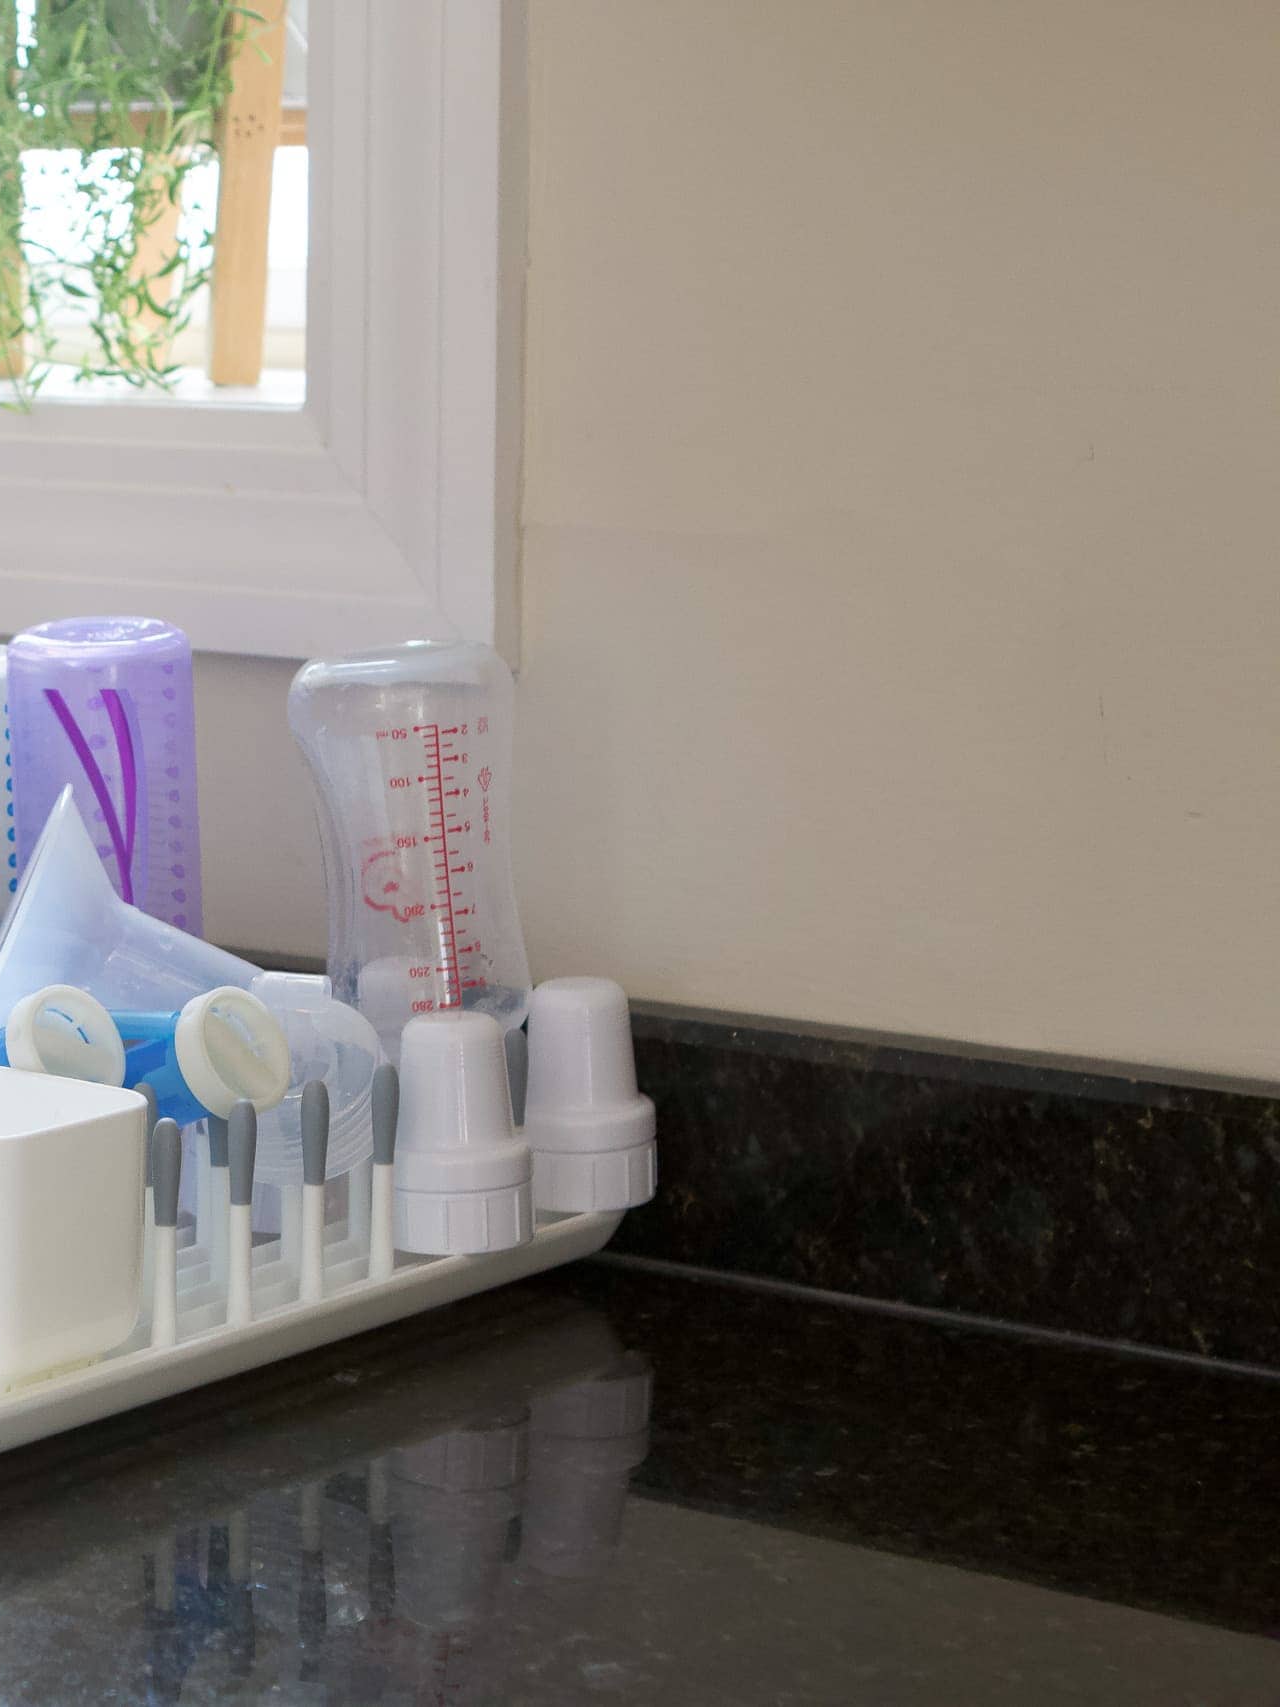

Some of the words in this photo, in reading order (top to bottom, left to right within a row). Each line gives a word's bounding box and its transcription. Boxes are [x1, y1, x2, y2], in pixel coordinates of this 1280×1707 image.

[391, 728, 407, 740] 50
[461, 724, 468, 735] 2
[462, 753, 468, 763] 3
[390, 777, 411, 788] 100
[463, 788, 469, 797] 4
[464, 821, 471, 832] 5
[396, 837, 417, 848] 150
[467, 862, 474, 872] 6
[404, 904, 424, 917] 200
[409, 967, 430, 978] 250
[412, 1000, 433, 1012] 280
